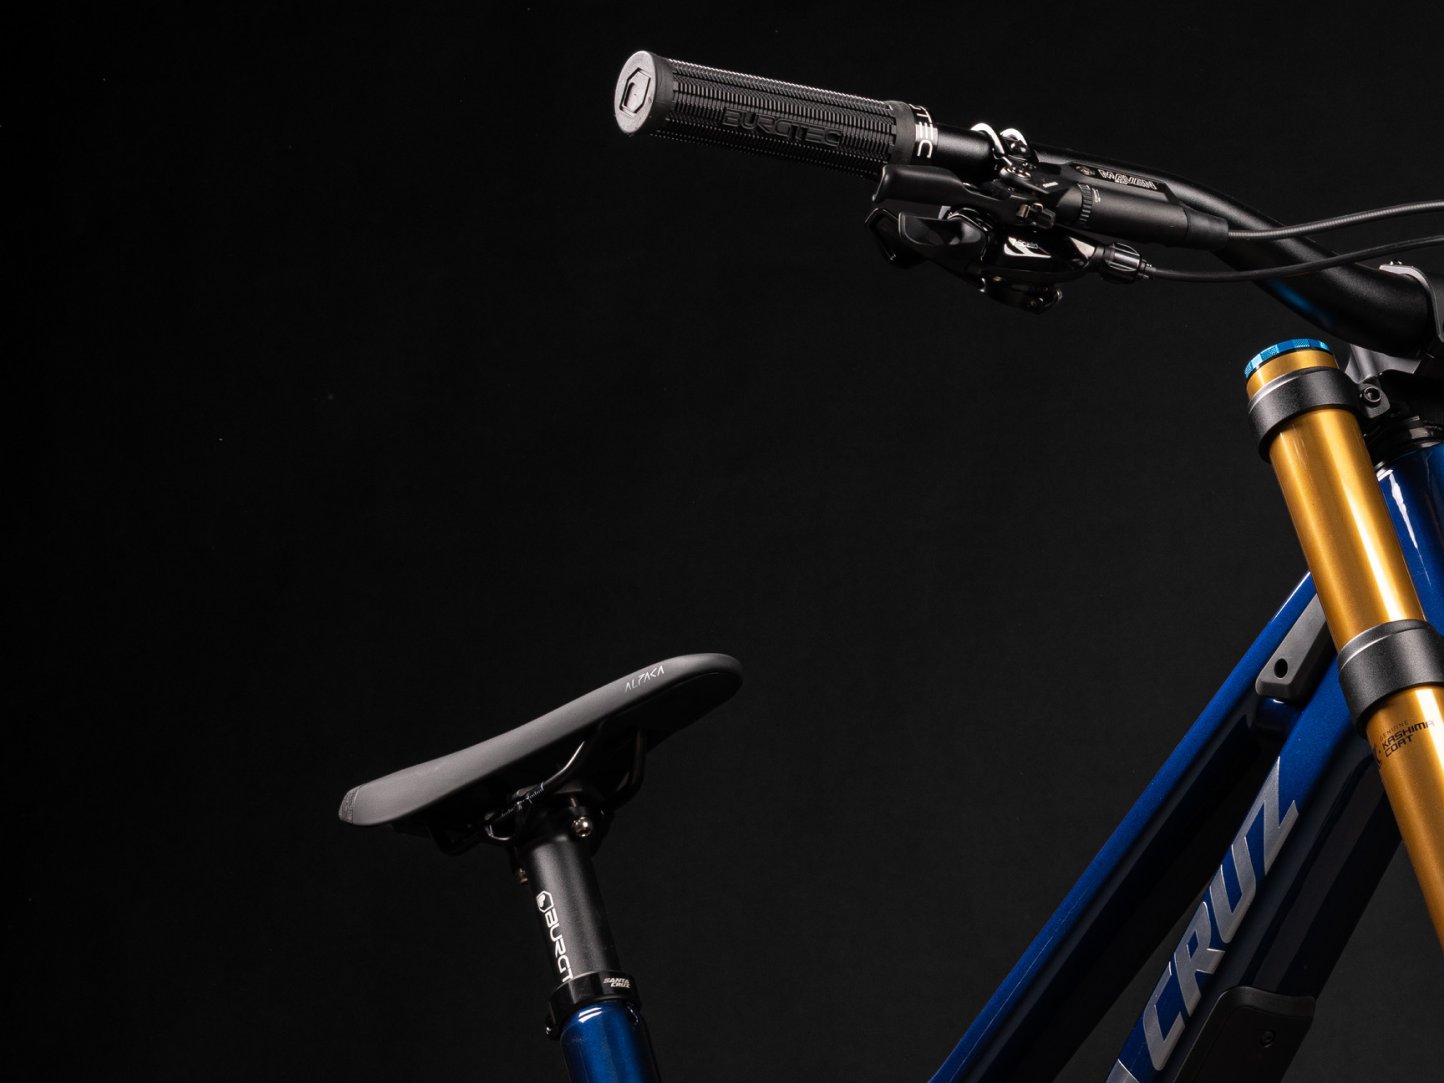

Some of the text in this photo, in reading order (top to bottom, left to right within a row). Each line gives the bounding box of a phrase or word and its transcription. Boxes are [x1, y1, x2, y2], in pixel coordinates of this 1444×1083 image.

[722, 108, 842, 147] BURGTEC
[625, 665, 665, 693] ALPACA
[1382, 720, 1436, 751] KASHIMA
[1385, 734, 1414, 757] COAT
[1142, 757, 1299, 1071] CRUZ
